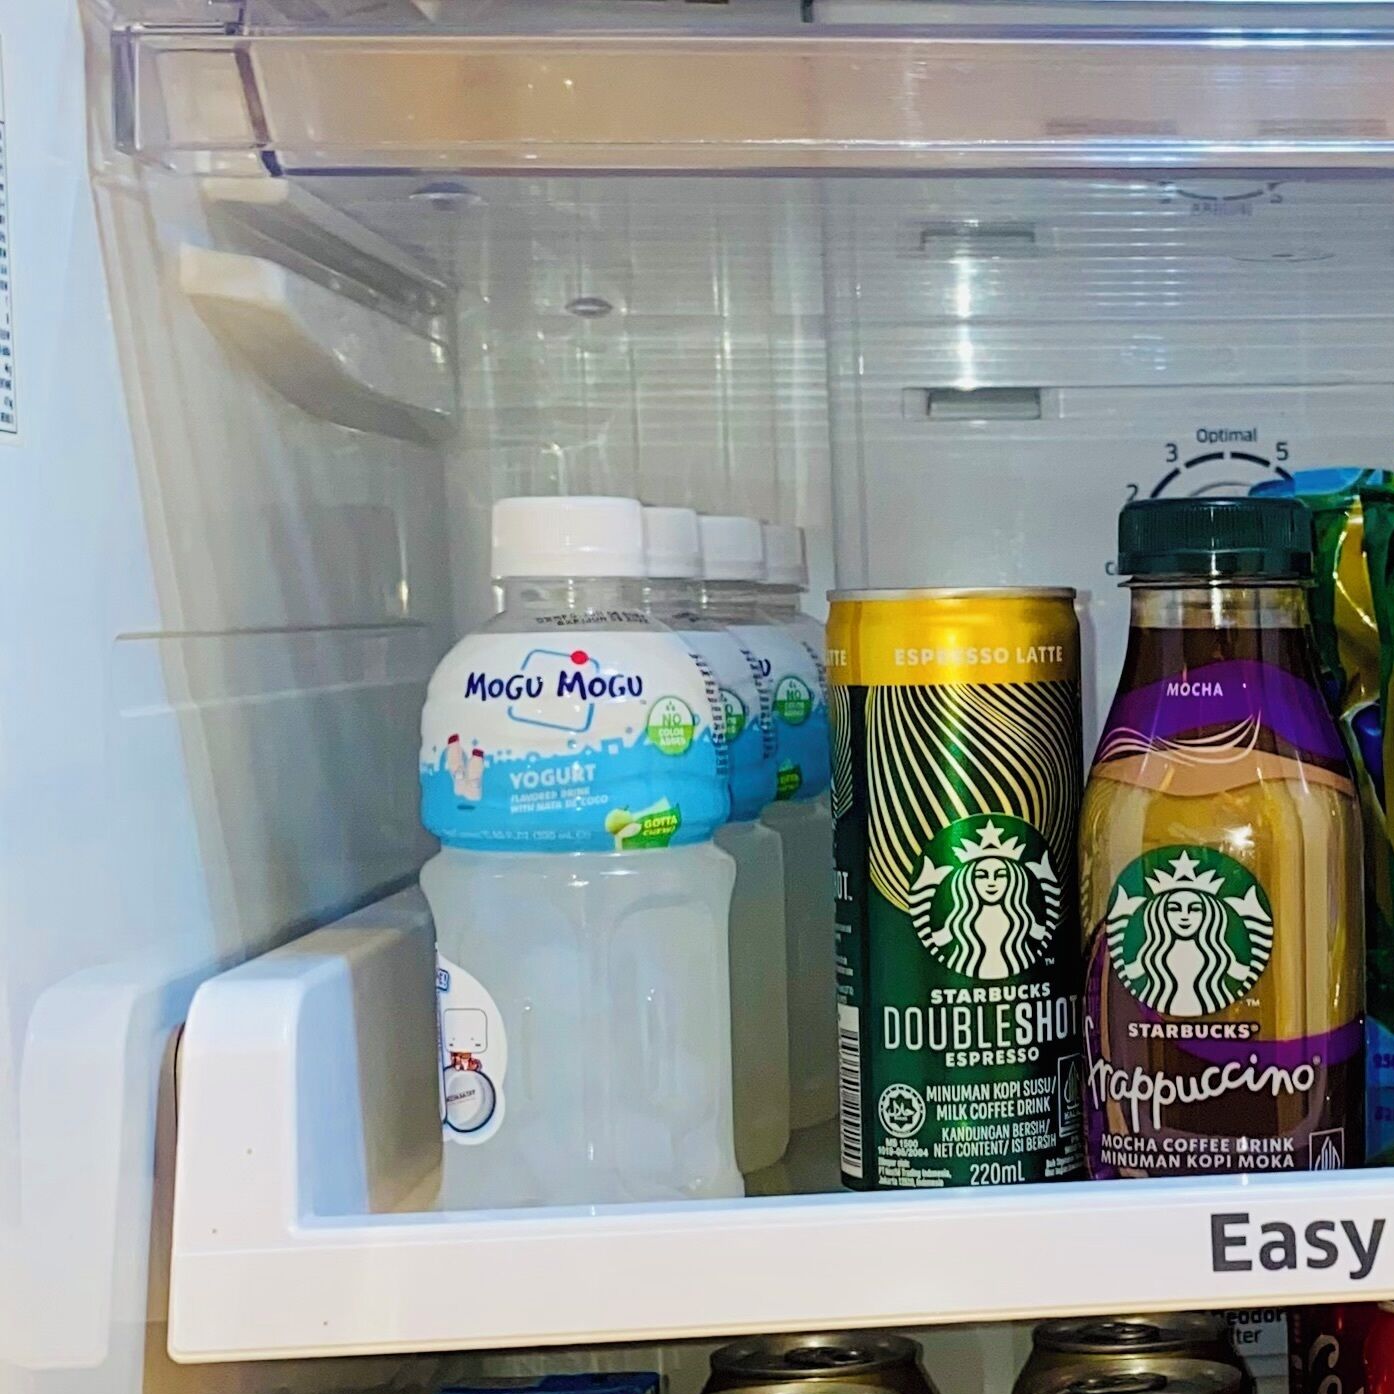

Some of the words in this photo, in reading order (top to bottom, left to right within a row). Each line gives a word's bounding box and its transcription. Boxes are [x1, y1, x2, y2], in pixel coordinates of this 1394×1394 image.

[1196, 428, 1257, 443] Optimal
[1166, 443, 1178, 462] 3
[1276, 442, 1288, 461] 5
[894, 647, 1009, 666] ESPRESSO
[1015, 645, 1063, 664] LATTE
[1166, 682, 1223, 697] MOCHA
[662, 714, 682, 727] NO
[510, 763, 596, 790] YOGURT
[931, 982, 1051, 1005] STARBUCKS
[884, 994, 1078, 1050] DOUBLESHOT
[946, 1047, 1040, 1067] ESPRESSO
[926, 1083, 991, 1102] MINUMAN
[993, 1081, 1021, 1099] KOPI
[936, 1104, 967, 1121] MILK
[970, 1100, 1015, 1119] COFFEE
[1017, 1097, 1051, 1115] DRINK
[942, 1124, 1010, 1142] KANDUNGAN
[1101, 1133, 1157, 1152] MOCHA
[1163, 1138, 1230, 1153] COFFEE
[1236, 1137, 1294, 1153] DRINK
[934, 1142, 954, 1158] NET
[956, 1138, 1009, 1157] CONTENT/
[1012, 1137, 1024, 1153] ISI
[1026, 1133, 1057, 1150] BERSIH
[1101, 1150, 1181, 1168] MINUMAN
[1191, 1154, 1232, 1168] KOPI
[1238, 1153, 1294, 1168] MOKA
[970, 1160, 1026, 1186] 220mL
[1210, 1212, 1386, 1280] Easy
